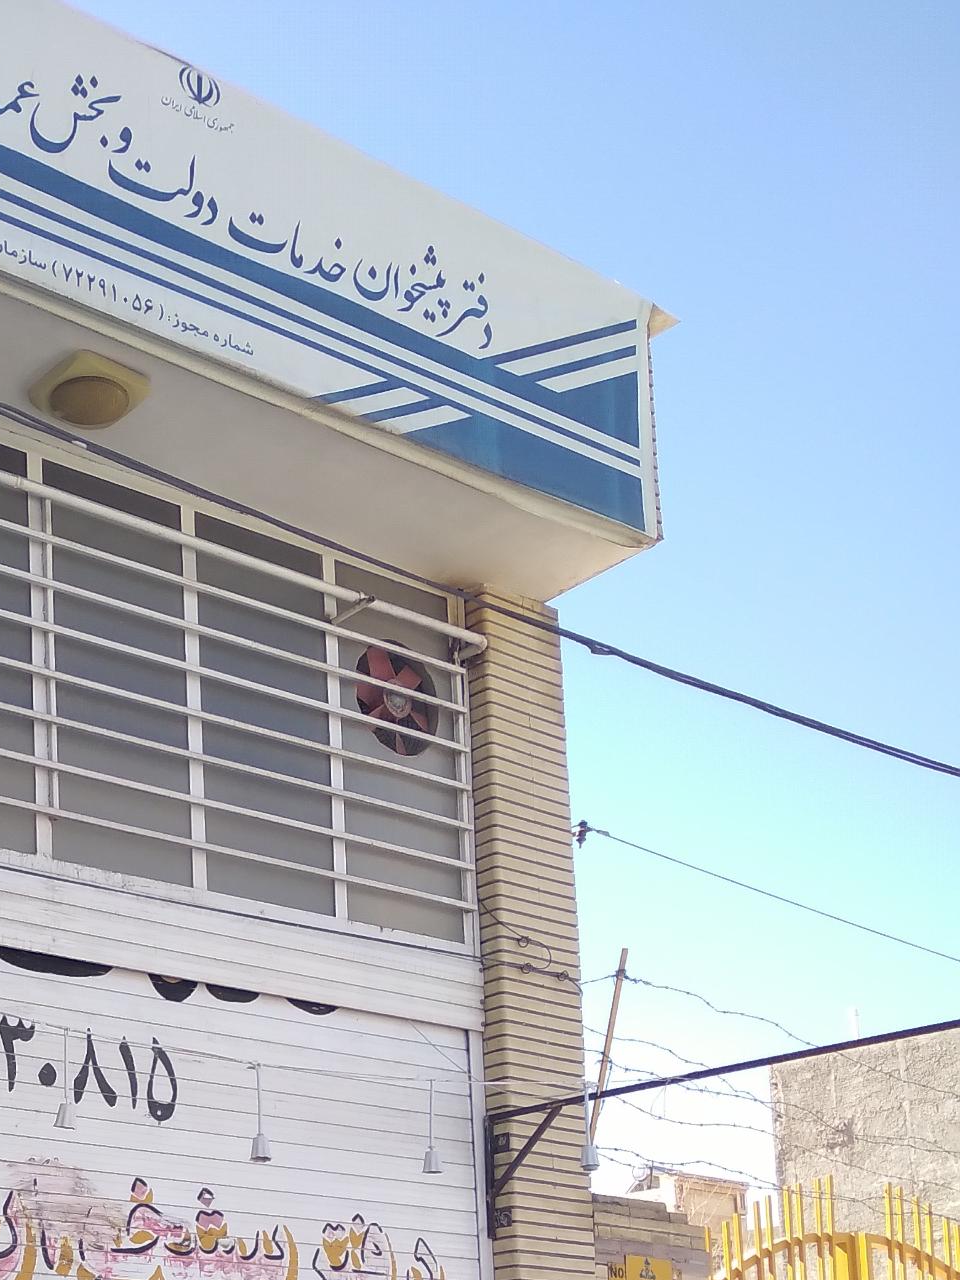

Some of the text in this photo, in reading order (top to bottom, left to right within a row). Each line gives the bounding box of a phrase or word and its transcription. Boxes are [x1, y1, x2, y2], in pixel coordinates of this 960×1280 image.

[29, 73, 122, 154] بخش
[160, 95, 183, 113] ایران
[107, 154, 219, 226] دولت
[227, 210, 347, 283] خدمات
[352, 244, 450, 323] پیشخوان
[435, 272, 493, 350] دفتر
[212, 333, 255, 357] شماره
